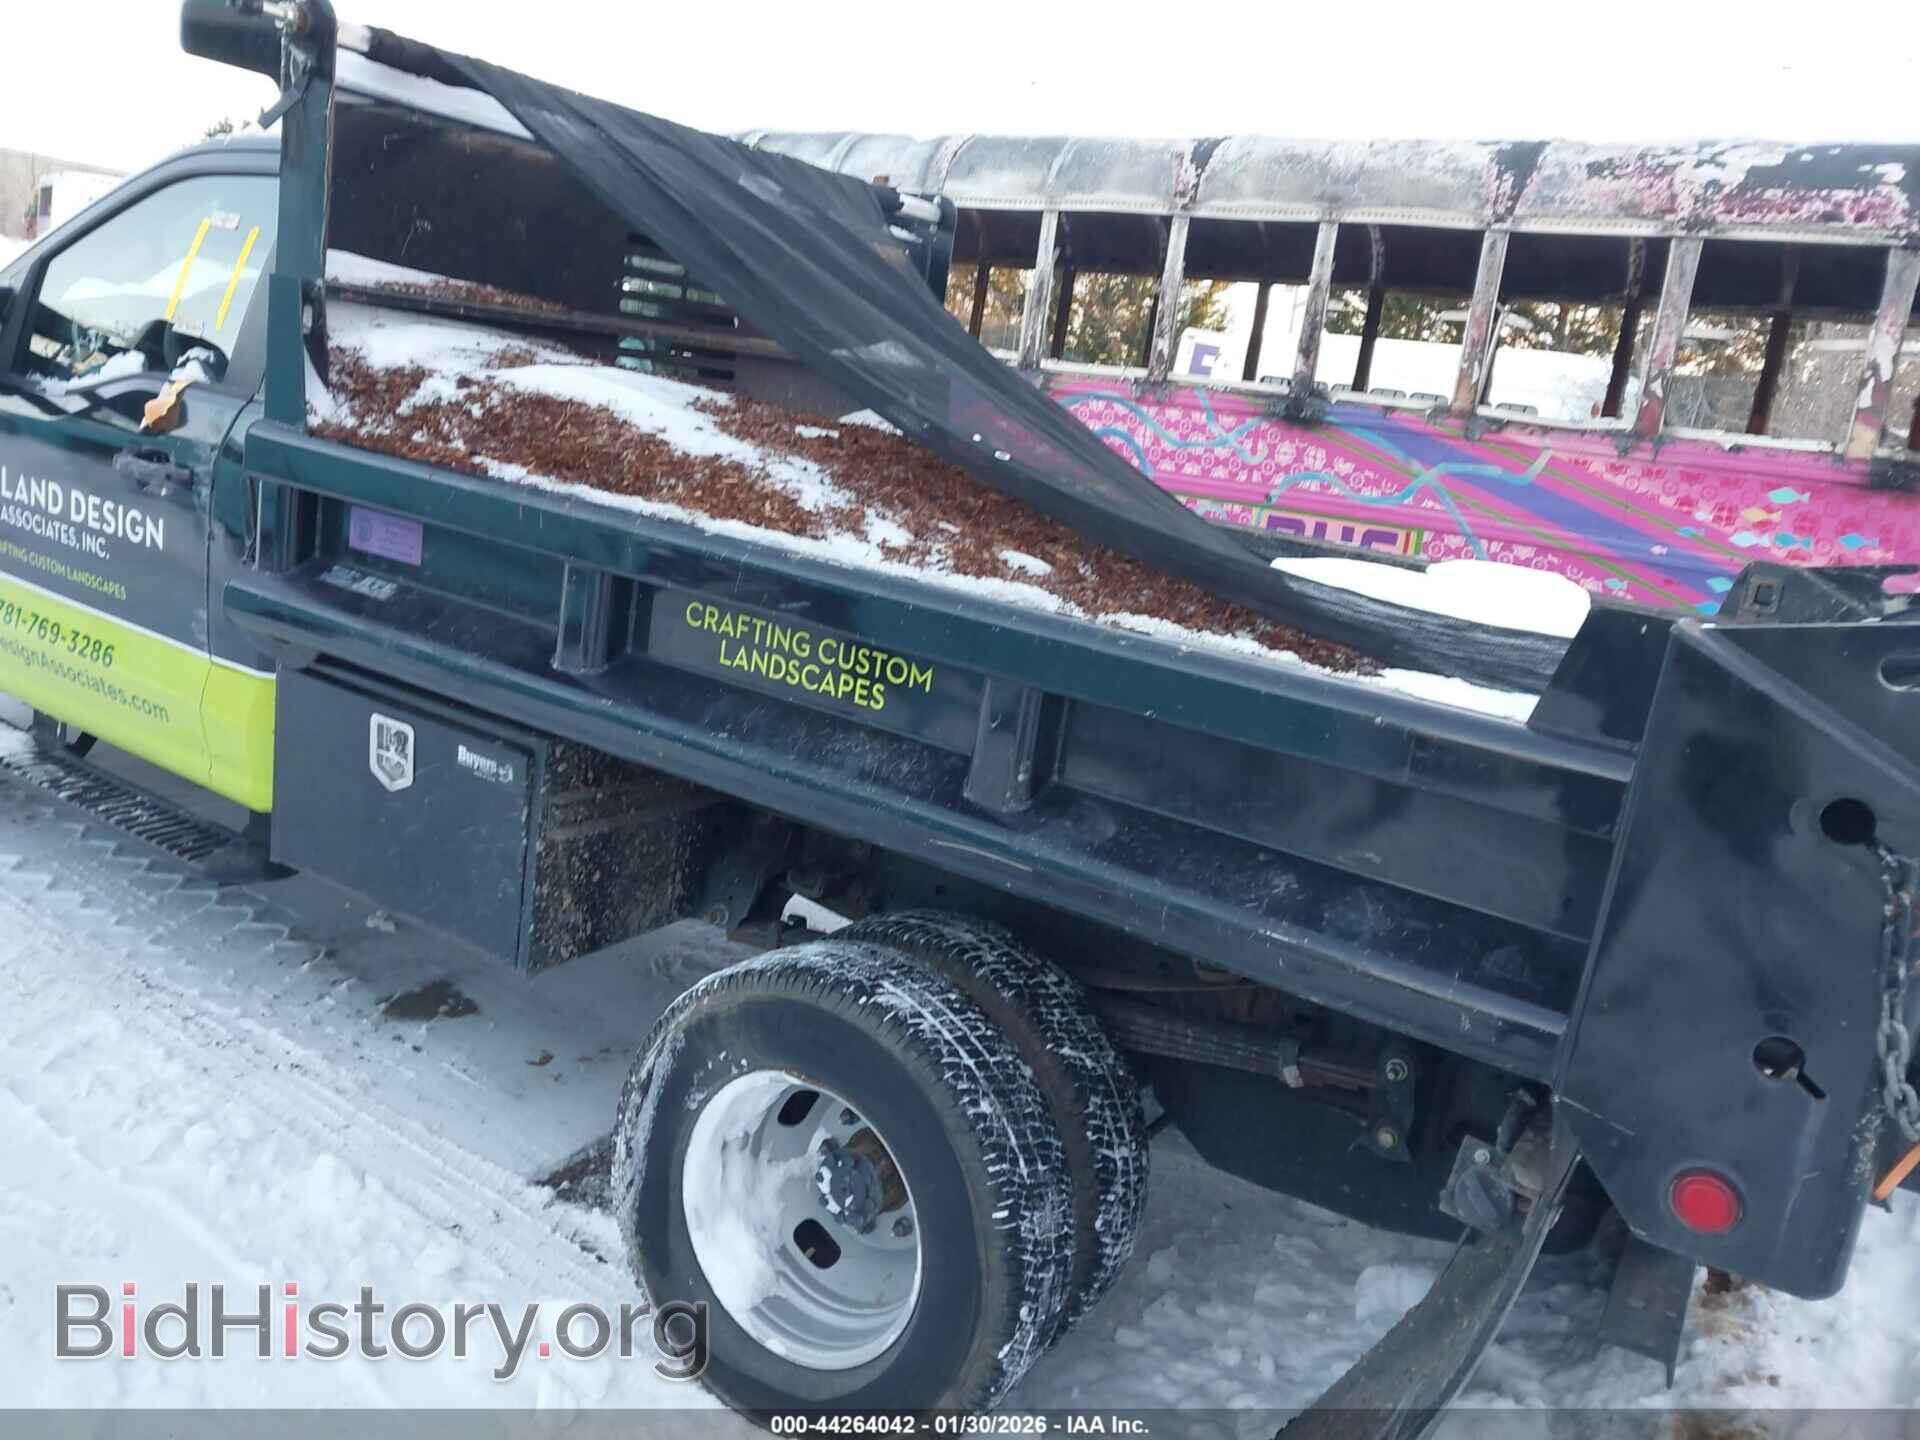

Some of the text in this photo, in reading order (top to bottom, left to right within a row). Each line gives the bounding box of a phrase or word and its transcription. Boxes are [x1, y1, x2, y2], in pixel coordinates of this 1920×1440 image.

[1, 465, 165, 550] LAND DESIGN
[29, 551, 66, 577] CUSTOM
[67, 565, 126, 600] LANDSCAPES
[685, 601, 935, 693] CRAFTING CUSTOM
[719, 640, 885, 710] LANDSCAPES
